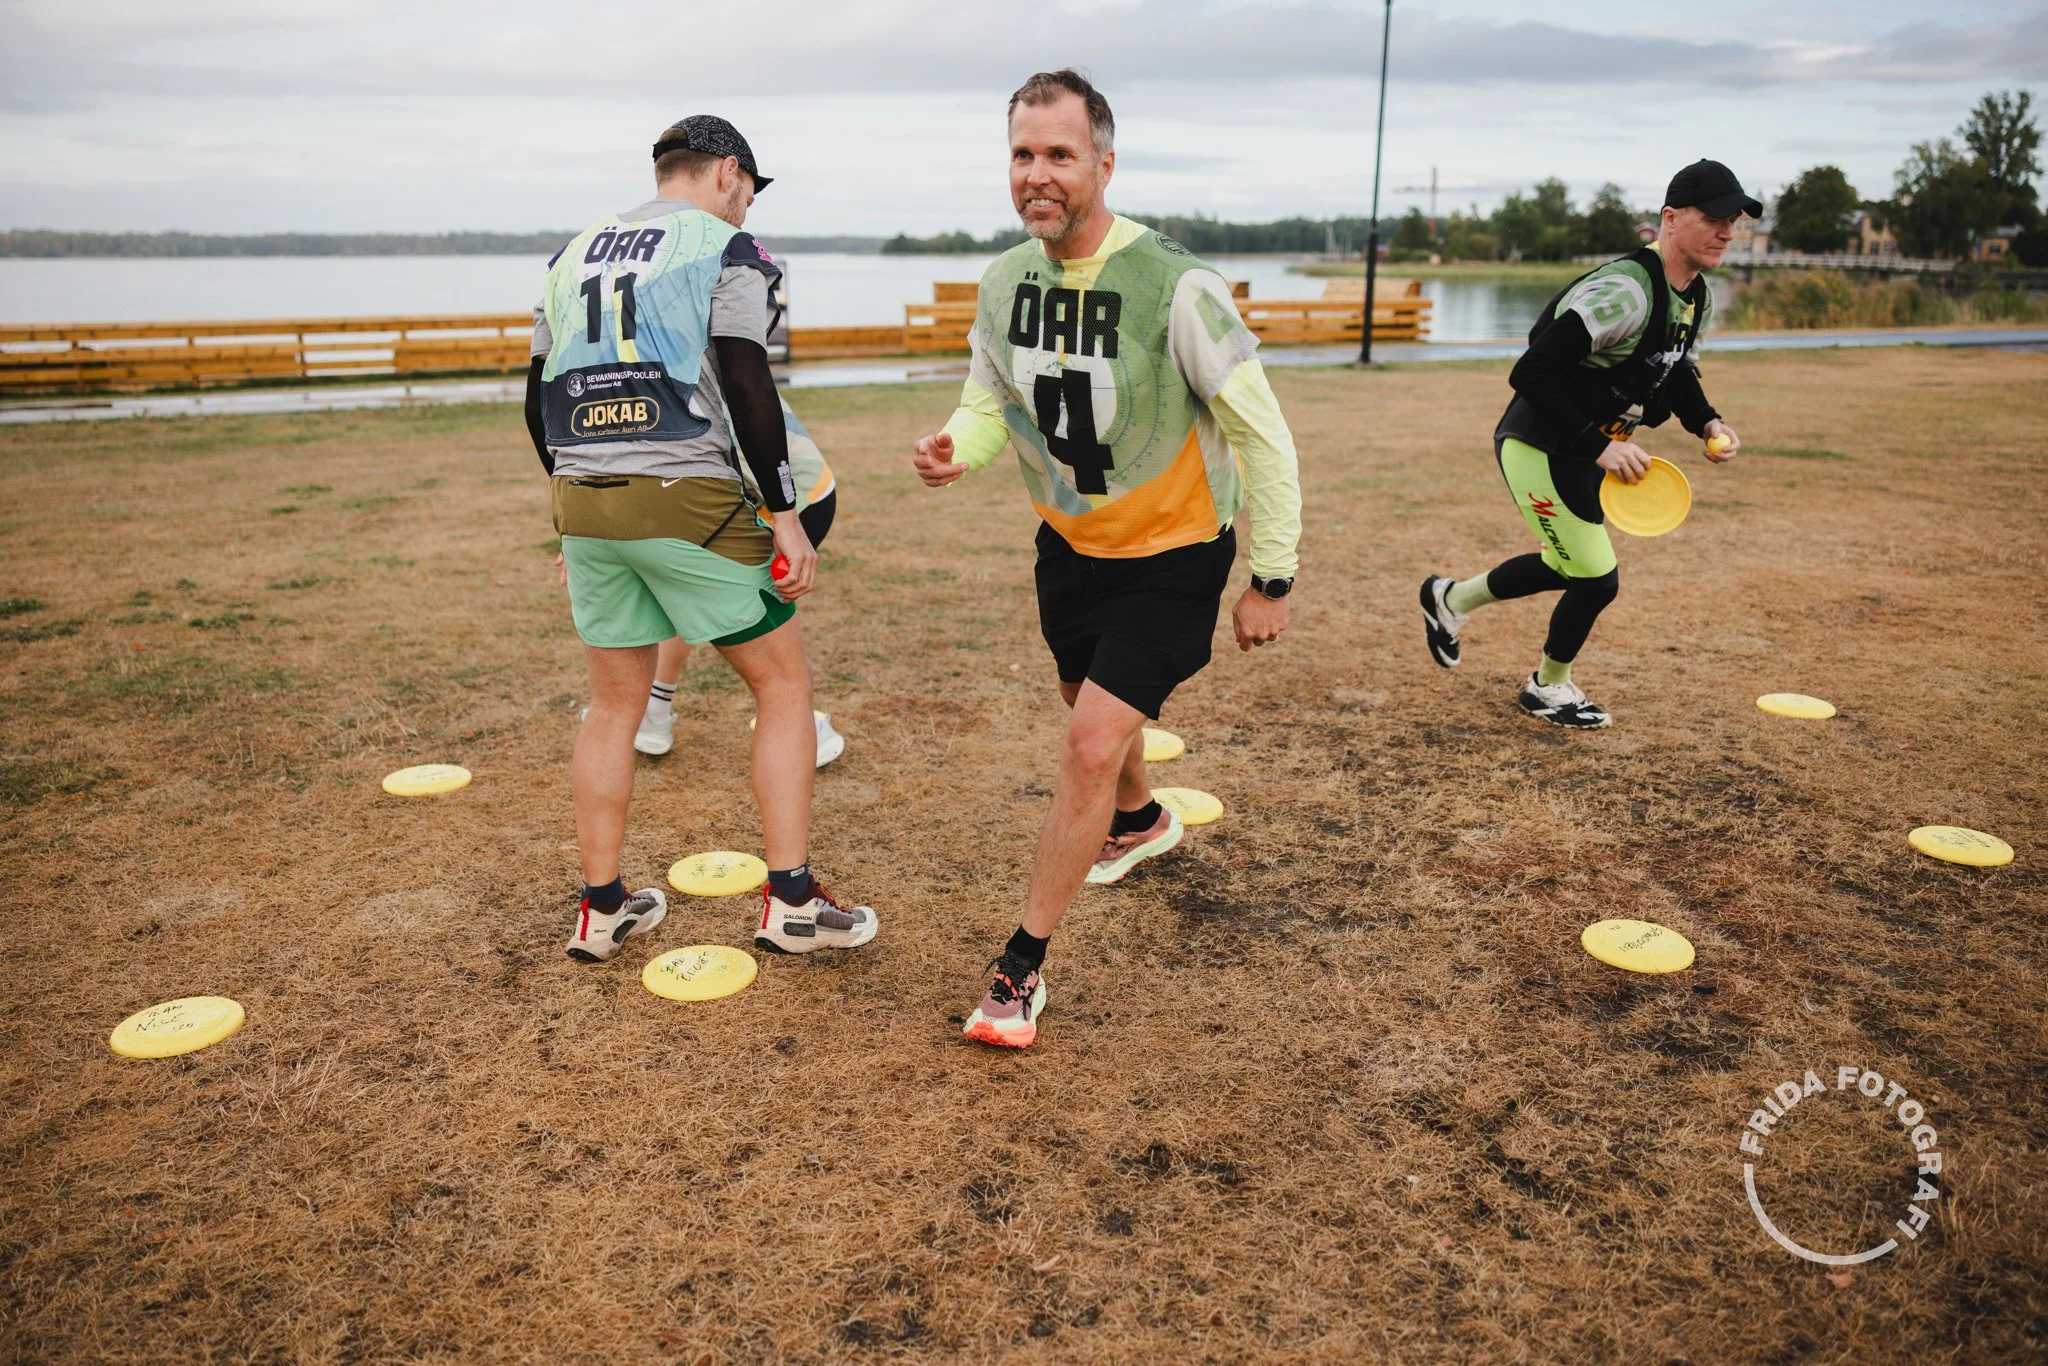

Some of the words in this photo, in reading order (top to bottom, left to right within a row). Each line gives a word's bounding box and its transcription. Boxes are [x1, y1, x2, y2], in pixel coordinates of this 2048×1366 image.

[583, 226, 666, 264] ÖAR
[579, 271, 638, 344] 11
[1007, 271, 1122, 359] ÖAR
[586, 370, 661, 384] BEVAKNINGSPOOLEN
[582, 402, 648, 427] JOKAB
[581, 430, 597, 438] John
[637, 424, 648, 432] AB
[1033, 368, 1115, 495] 4
[783, 913, 812, 921] SALOMON
